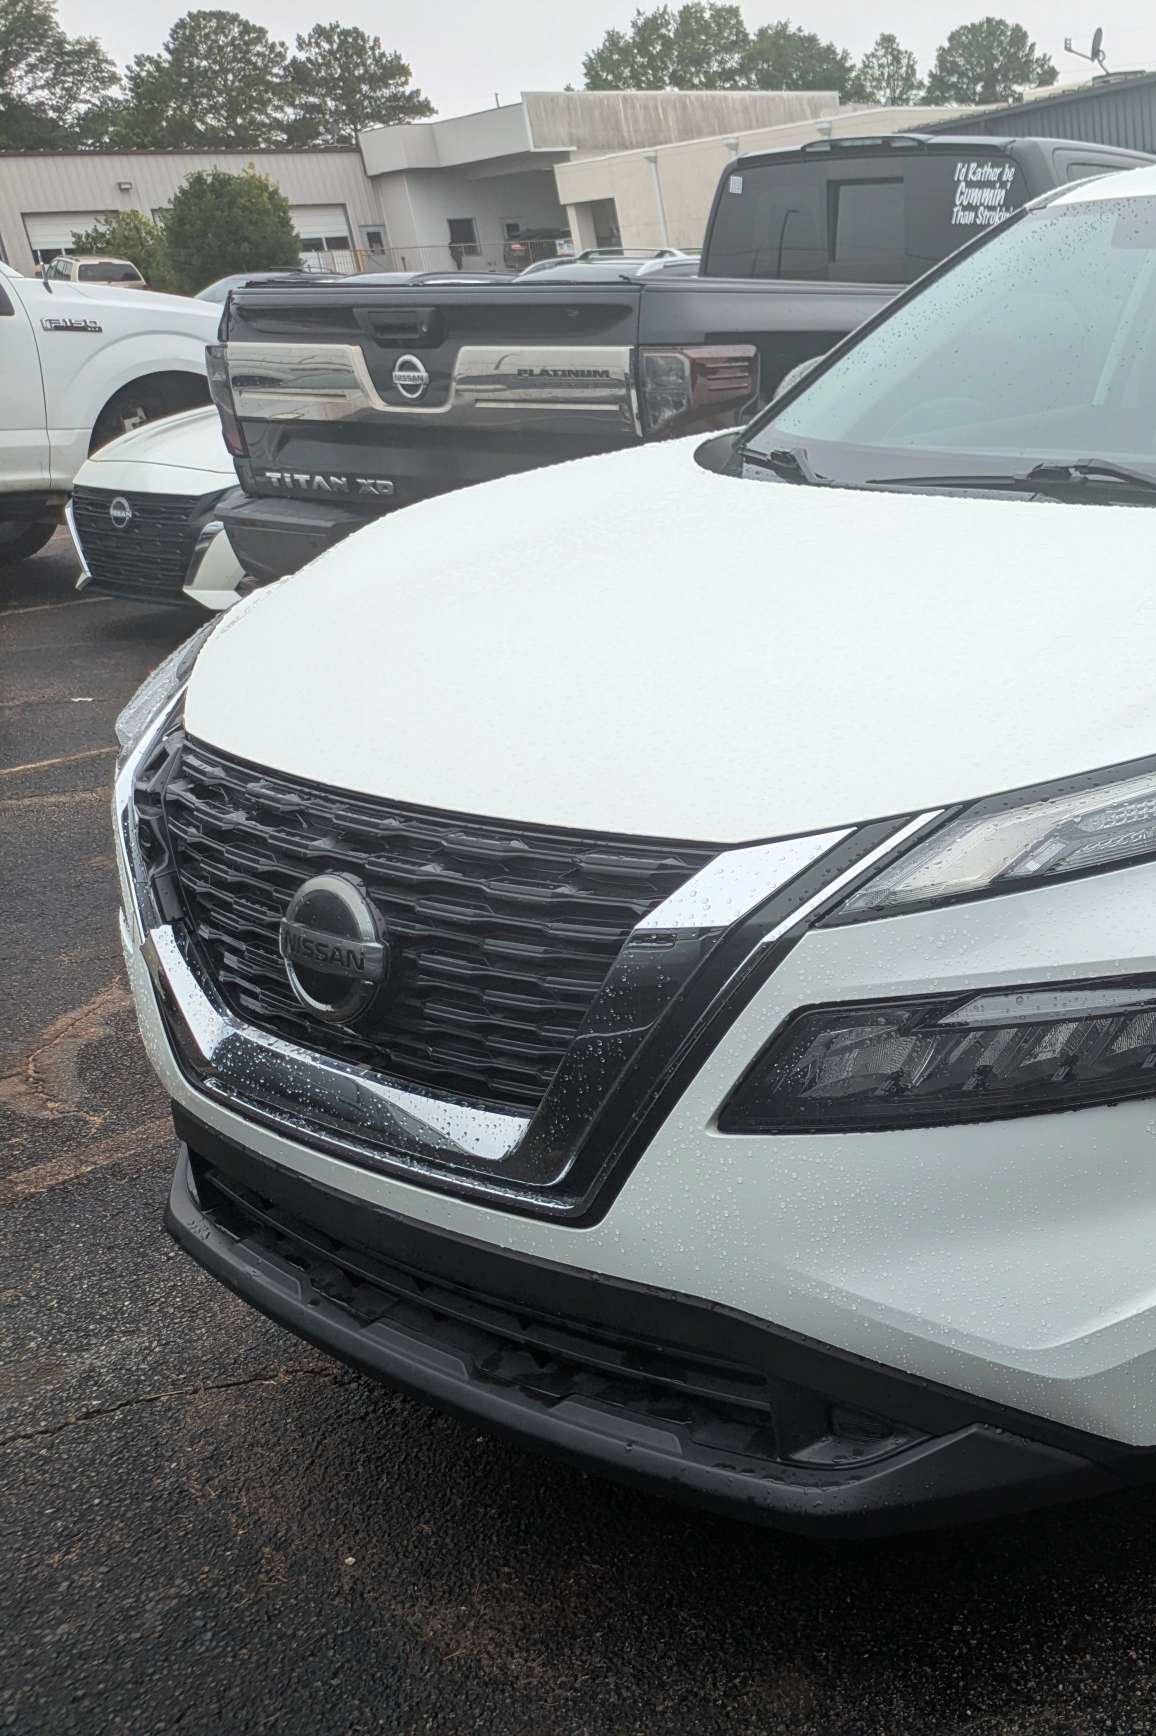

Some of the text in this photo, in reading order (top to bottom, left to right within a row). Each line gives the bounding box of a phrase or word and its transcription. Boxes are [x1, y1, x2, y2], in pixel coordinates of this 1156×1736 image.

[955, 162, 1015, 181] I'd Rather be
[952, 206, 976, 225] Than
[517, 368, 610, 379] PLATINUM
[265, 472, 394, 495] TITAN XD
[283, 928, 366, 970] NISSAN
